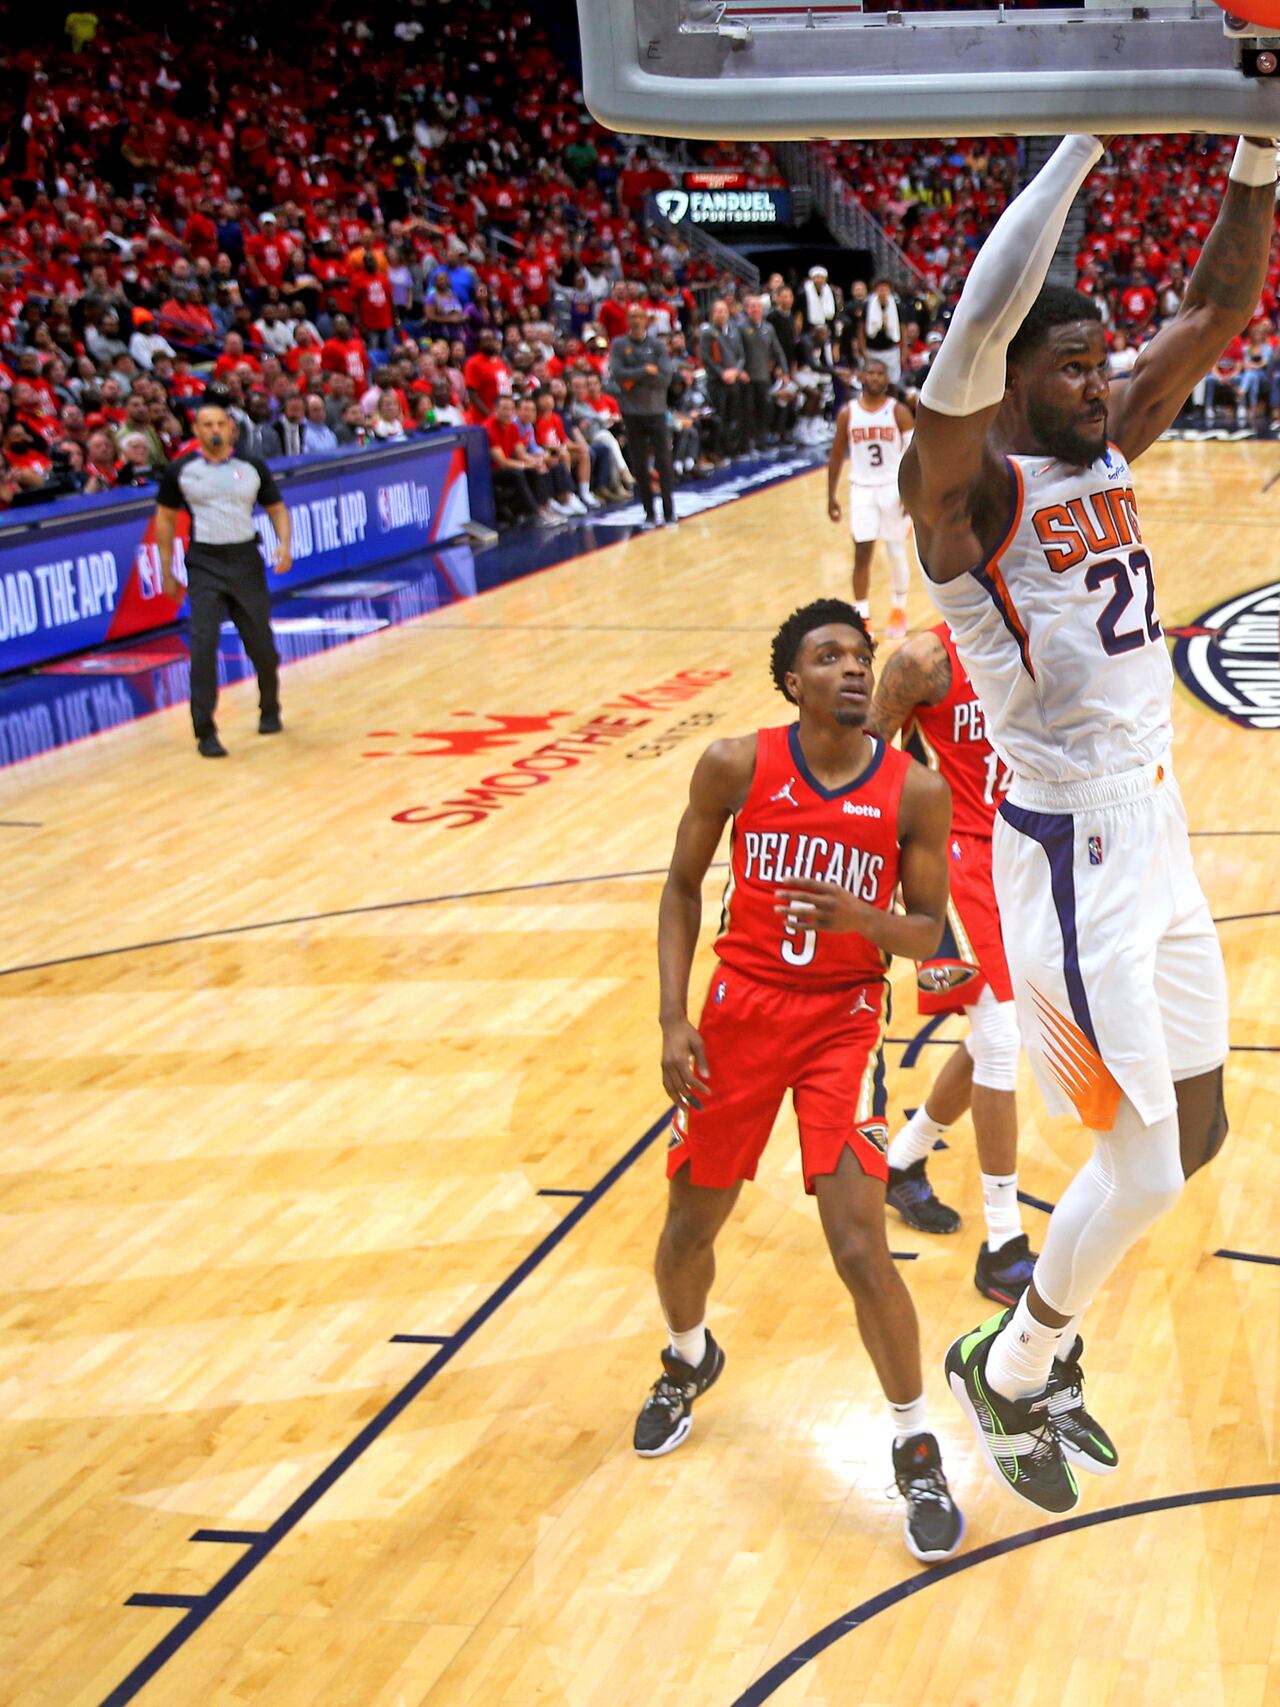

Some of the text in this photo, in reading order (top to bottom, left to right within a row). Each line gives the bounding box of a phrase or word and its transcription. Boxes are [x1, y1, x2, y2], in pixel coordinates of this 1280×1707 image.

[690, 191, 776, 211] FANDUEL
[690, 209, 777, 223] SPORTSBOOK
[867, 443, 883, 467] 3
[310, 497, 342, 553] THE
[339, 490, 367, 545] APP
[34, 560, 80, 630] THE
[78, 550, 118, 619] APP
[391, 668, 733, 830] SMOOTHIE KING
[842, 800, 881, 818] ibotta
[744, 832, 884, 902] PELICANS
